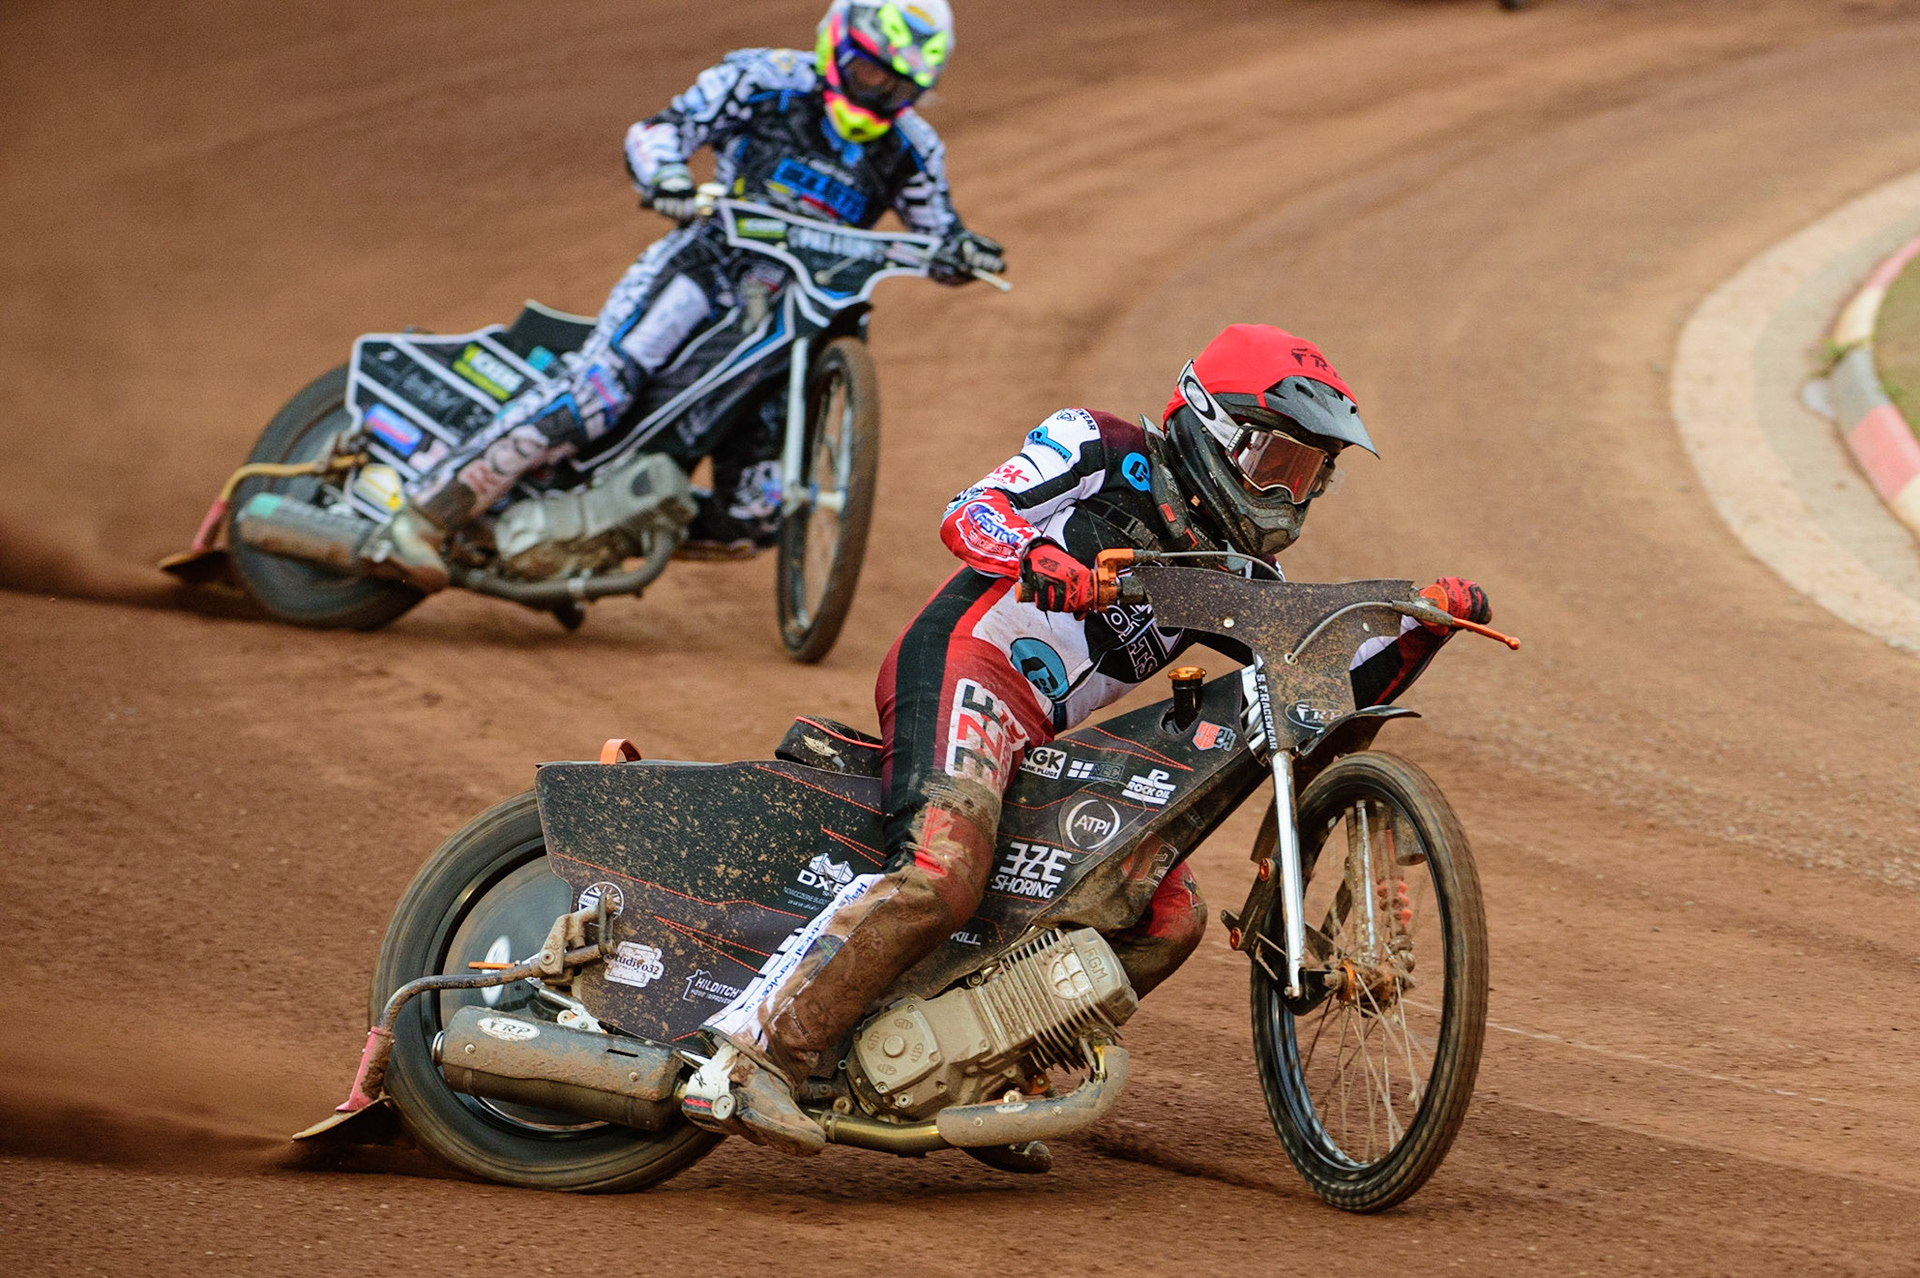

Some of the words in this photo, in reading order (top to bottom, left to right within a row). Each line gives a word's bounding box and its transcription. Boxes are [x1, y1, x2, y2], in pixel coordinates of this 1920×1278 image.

[1127, 780, 1156, 797] ROCK
[1155, 788, 1171, 799] OIL
[1074, 814, 1111, 835] ATPI
[991, 874, 1058, 899] SHORING
